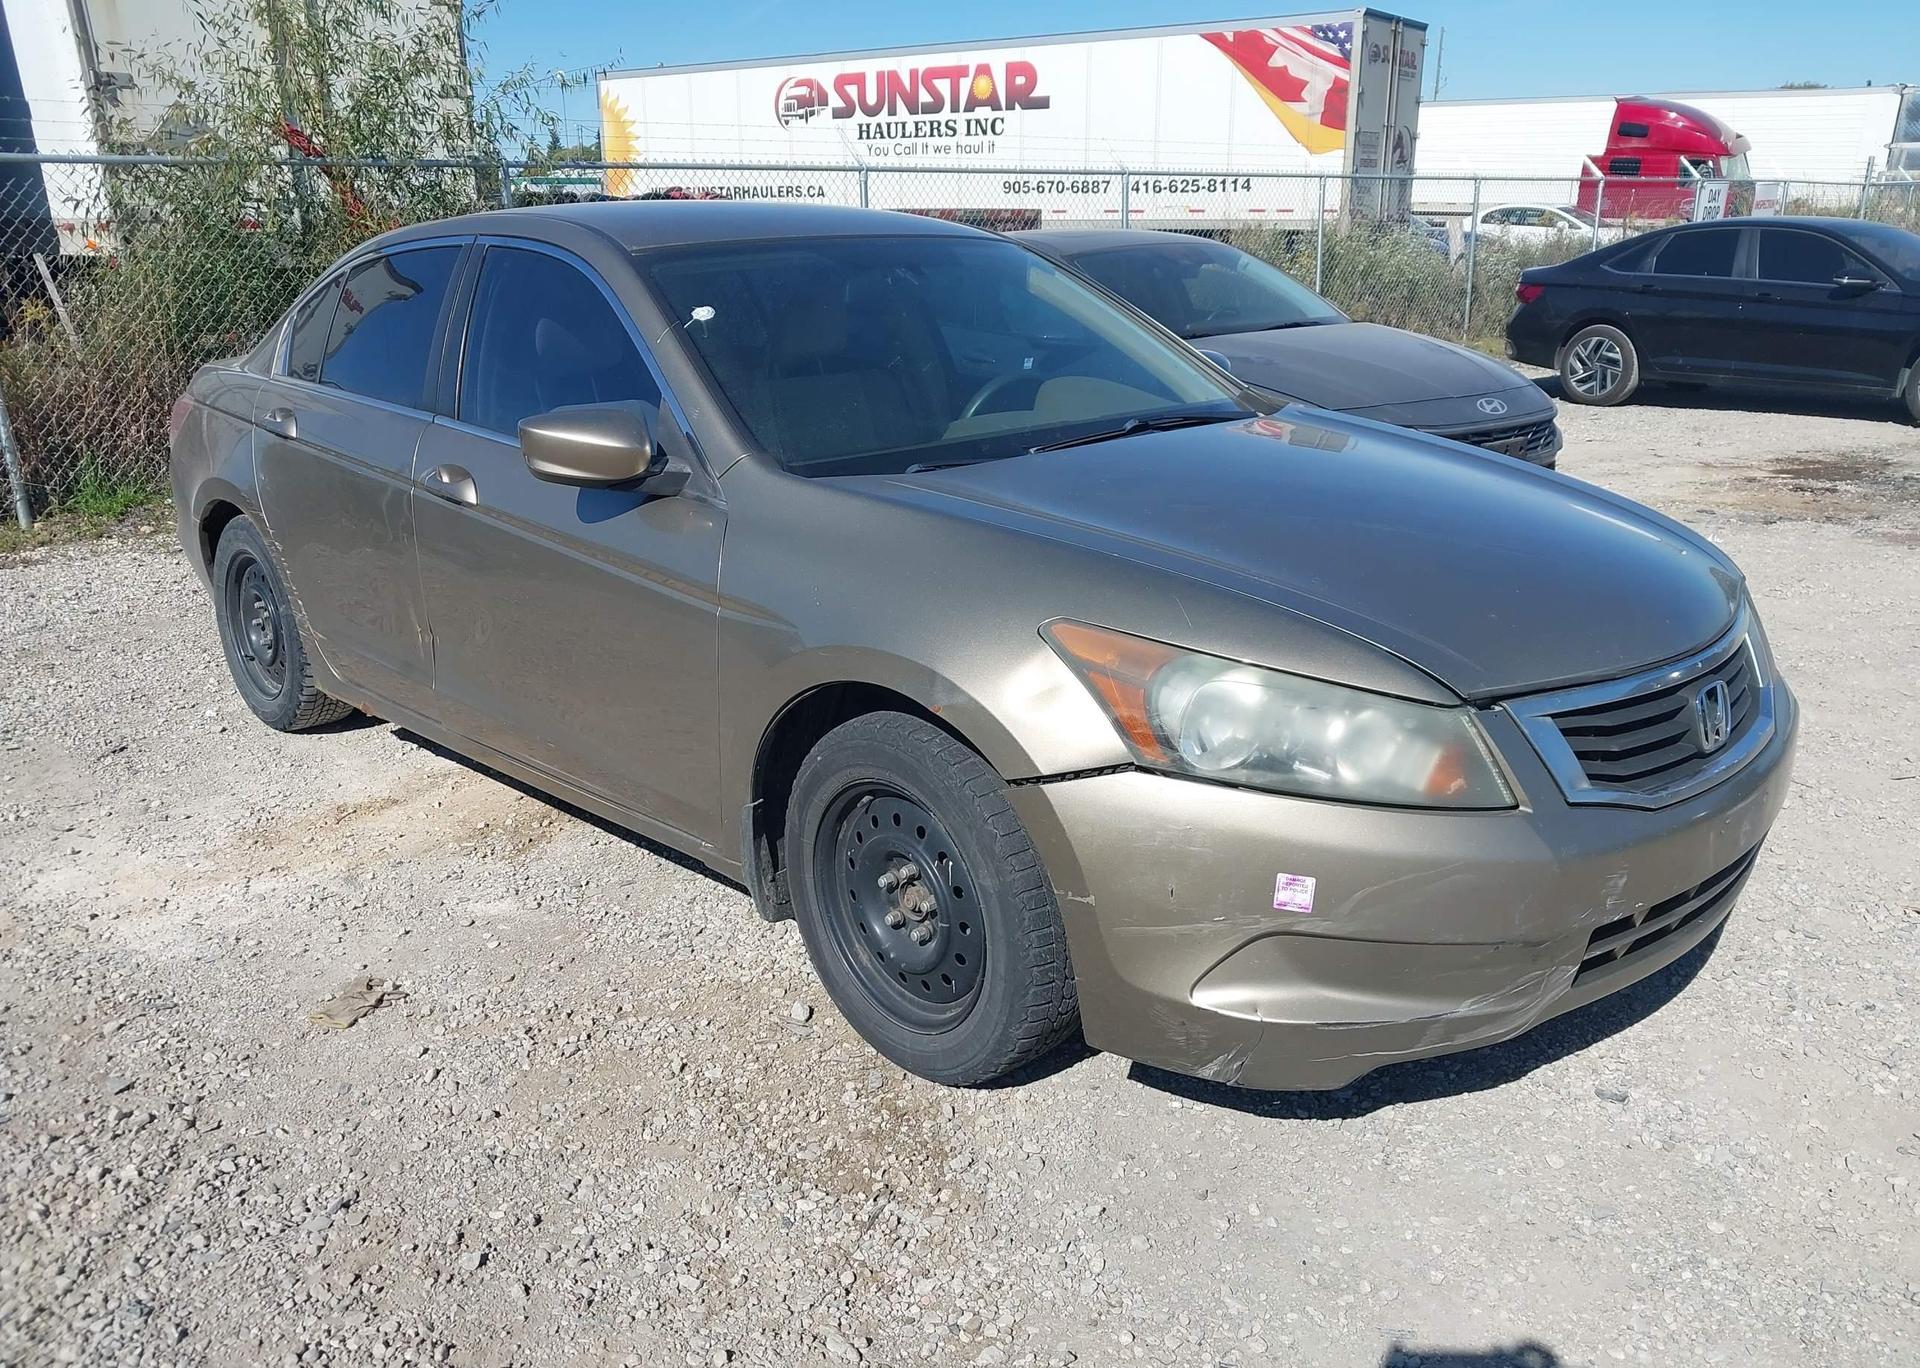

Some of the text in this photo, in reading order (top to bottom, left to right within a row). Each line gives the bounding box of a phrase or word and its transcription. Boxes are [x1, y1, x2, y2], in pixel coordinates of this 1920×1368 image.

[832, 60, 1050, 120] SUNSTAR
[857, 117, 1005, 140] HAULERS INC
[867, 143, 889, 157] You
[893, 142, 918, 156] Call
[933, 143, 951, 154] we
[956, 140, 984, 154] haul
[988, 140, 996, 153] it
[1003, 177, 1252, 195] 905-670-6887 416-625-8114
[1708, 188, 1722, 204] DAY
[1703, 205, 1721, 220] DROP
